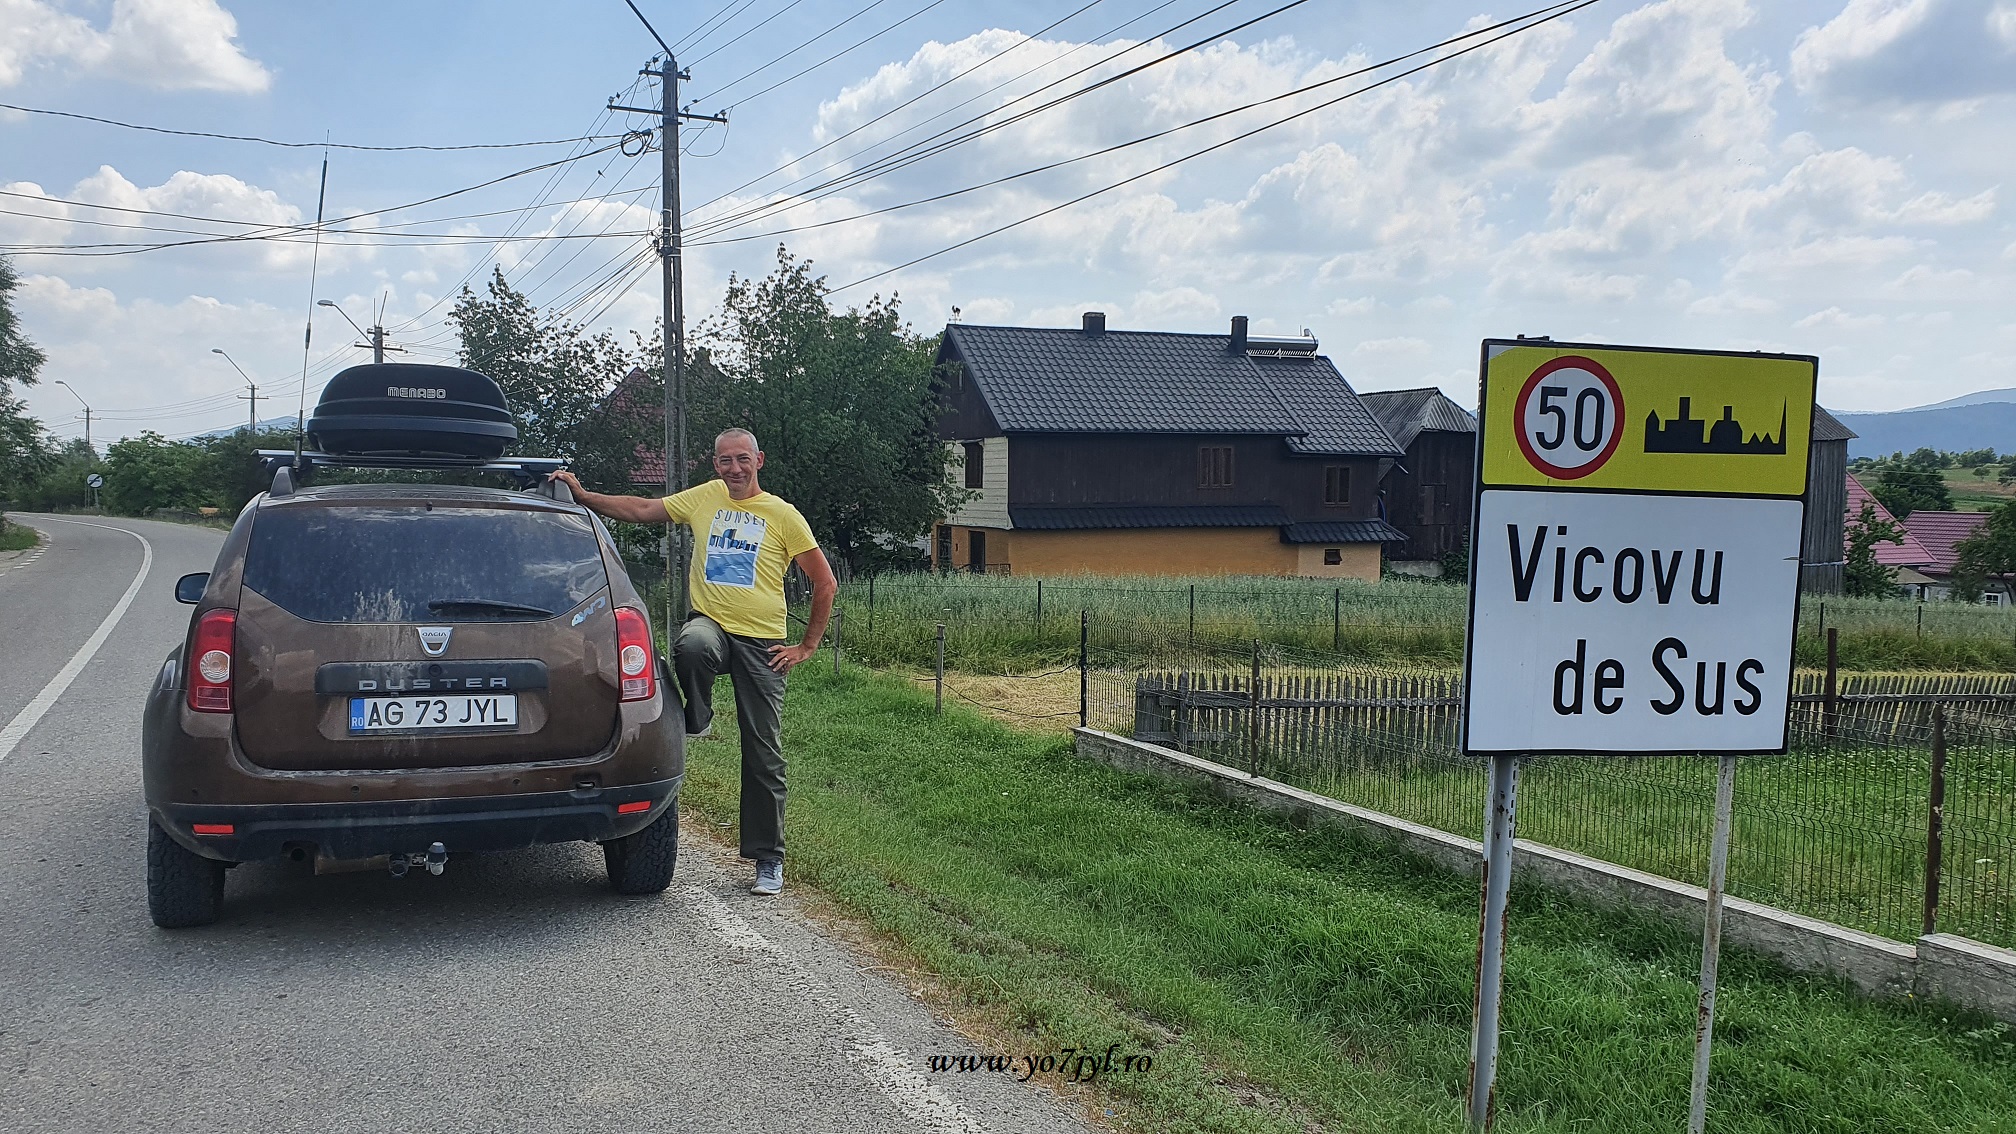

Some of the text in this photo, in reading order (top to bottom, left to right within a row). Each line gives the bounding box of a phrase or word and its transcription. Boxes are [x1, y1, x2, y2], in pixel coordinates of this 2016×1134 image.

[387, 386, 446, 399] MENABO
[1535, 386, 1605, 451] 50
[715, 509, 766, 527] SUNSET
[1507, 524, 1724, 605] Vicovu
[358, 677, 507, 691] DUSTER
[1552, 637, 1765, 716] de Sus
[351, 698, 508, 727] RO AG 73 JYL
